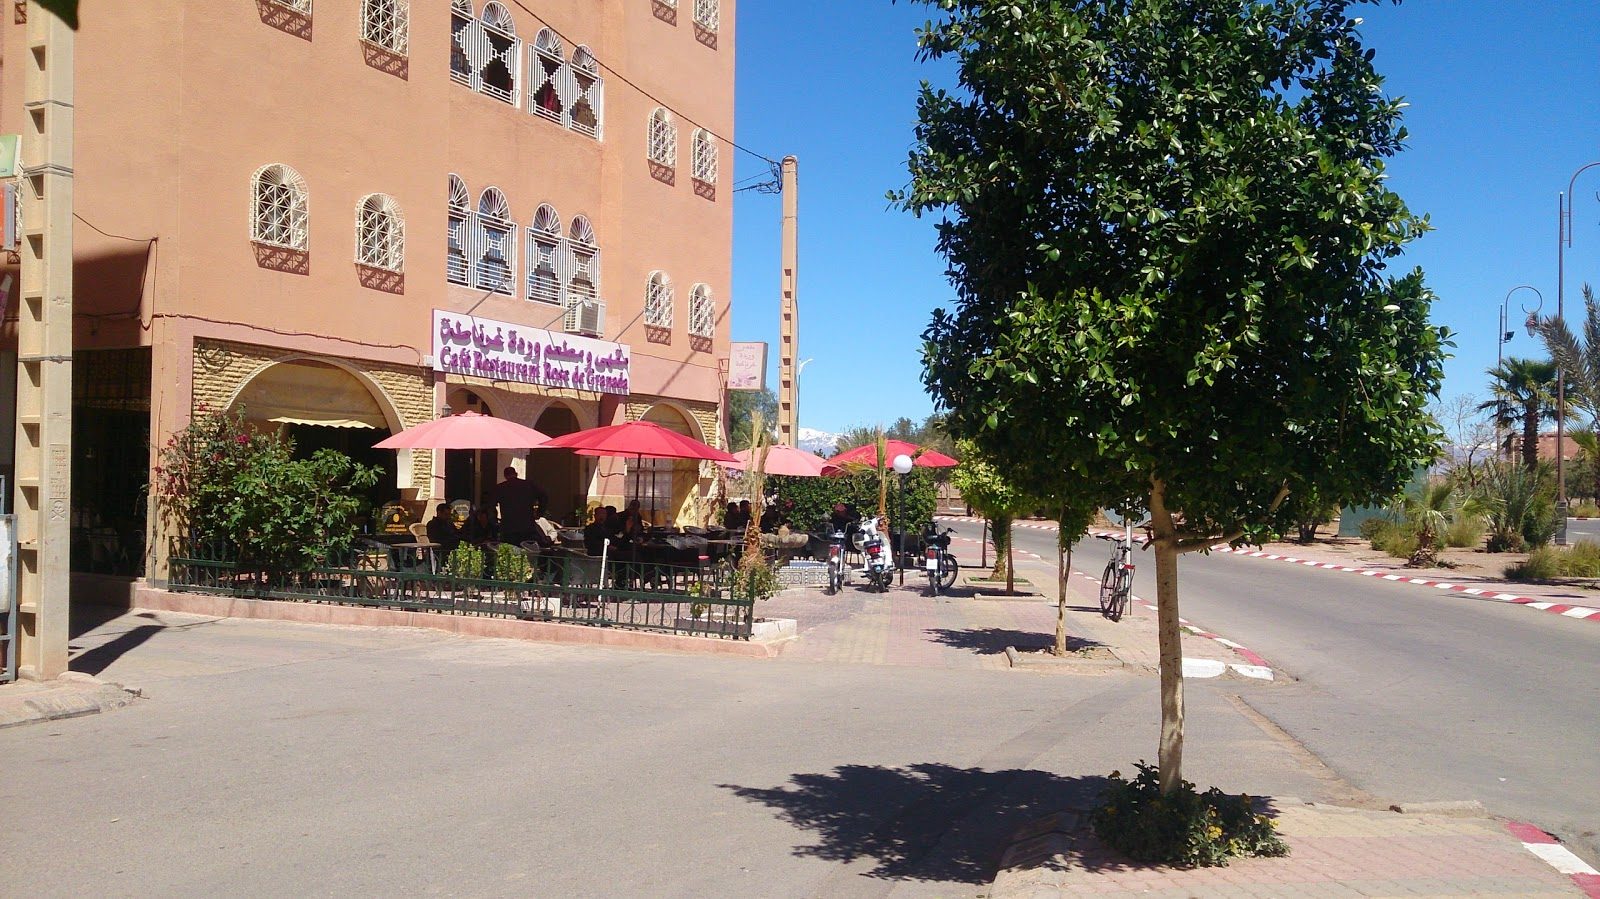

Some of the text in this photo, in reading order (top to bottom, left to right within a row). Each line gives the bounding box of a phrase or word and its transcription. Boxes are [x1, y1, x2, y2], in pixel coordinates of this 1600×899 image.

[440, 317, 505, 353] غرناطة
[440, 345, 472, 371] Café
[473, 350, 541, 381] Restaurant
[543, 362, 570, 383] Rose
[572, 365, 585, 386] de
